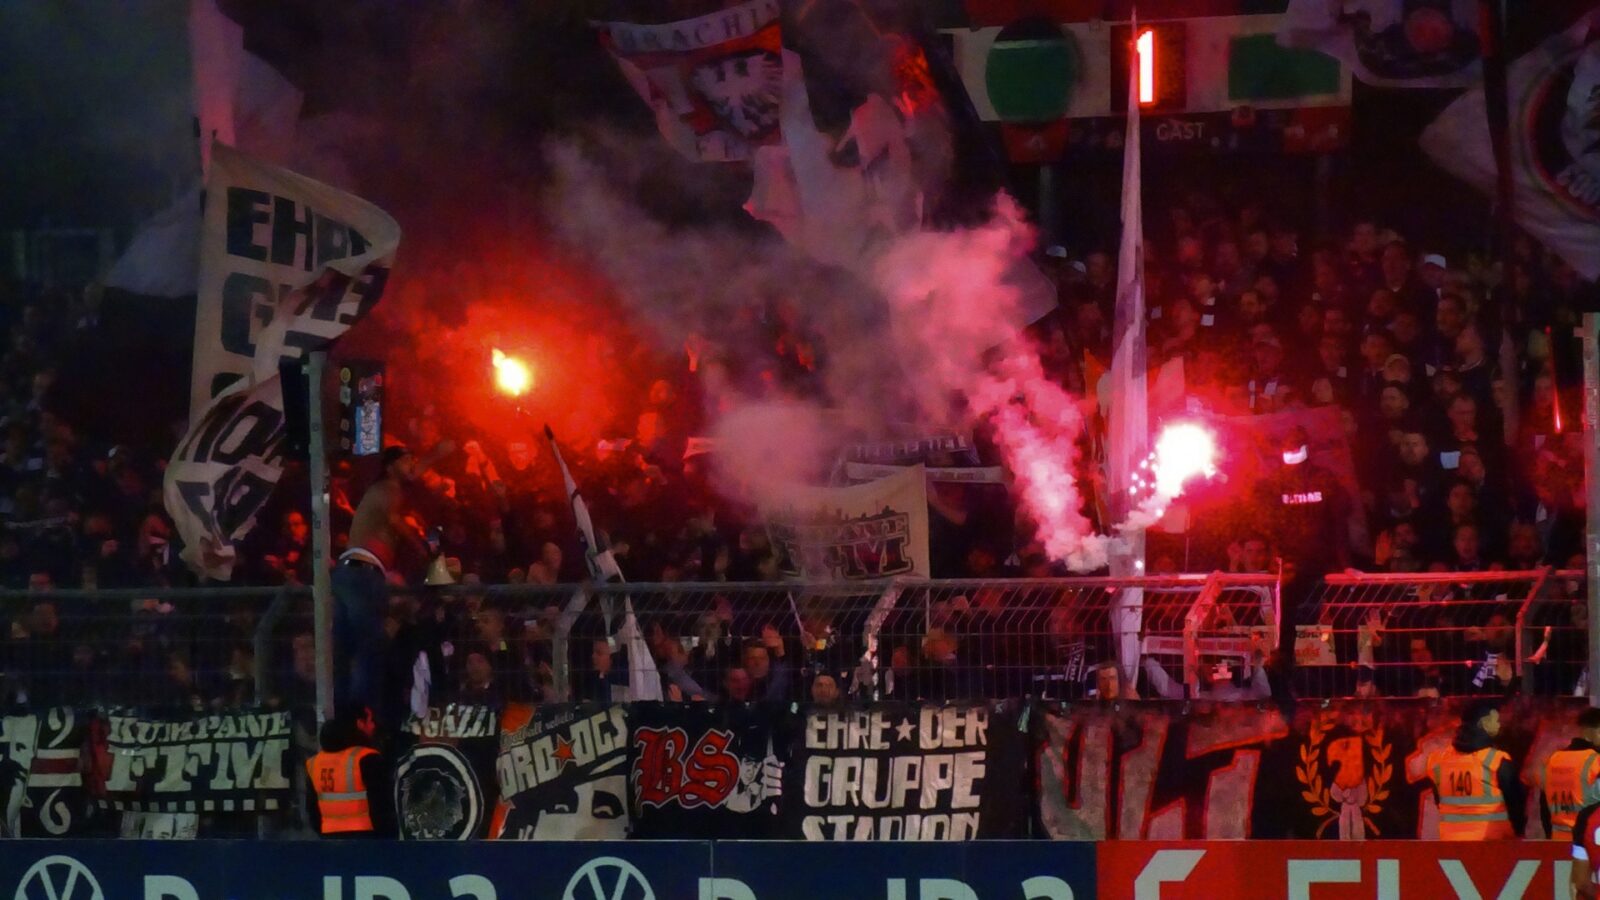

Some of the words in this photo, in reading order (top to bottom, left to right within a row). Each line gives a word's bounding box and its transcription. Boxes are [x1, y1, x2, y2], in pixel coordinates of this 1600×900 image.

[613, 3, 775, 50] BRACHI
[1156, 121, 1206, 141] GAST
[107, 710, 292, 745] KUMPANE
[805, 710, 891, 750] EHRE
[919, 705, 989, 750] DER
[104, 738, 291, 793] FFM
[804, 753, 986, 810] GRUPPE
[1449, 770, 1473, 797] 140
[39, 789, 72, 835] 6
